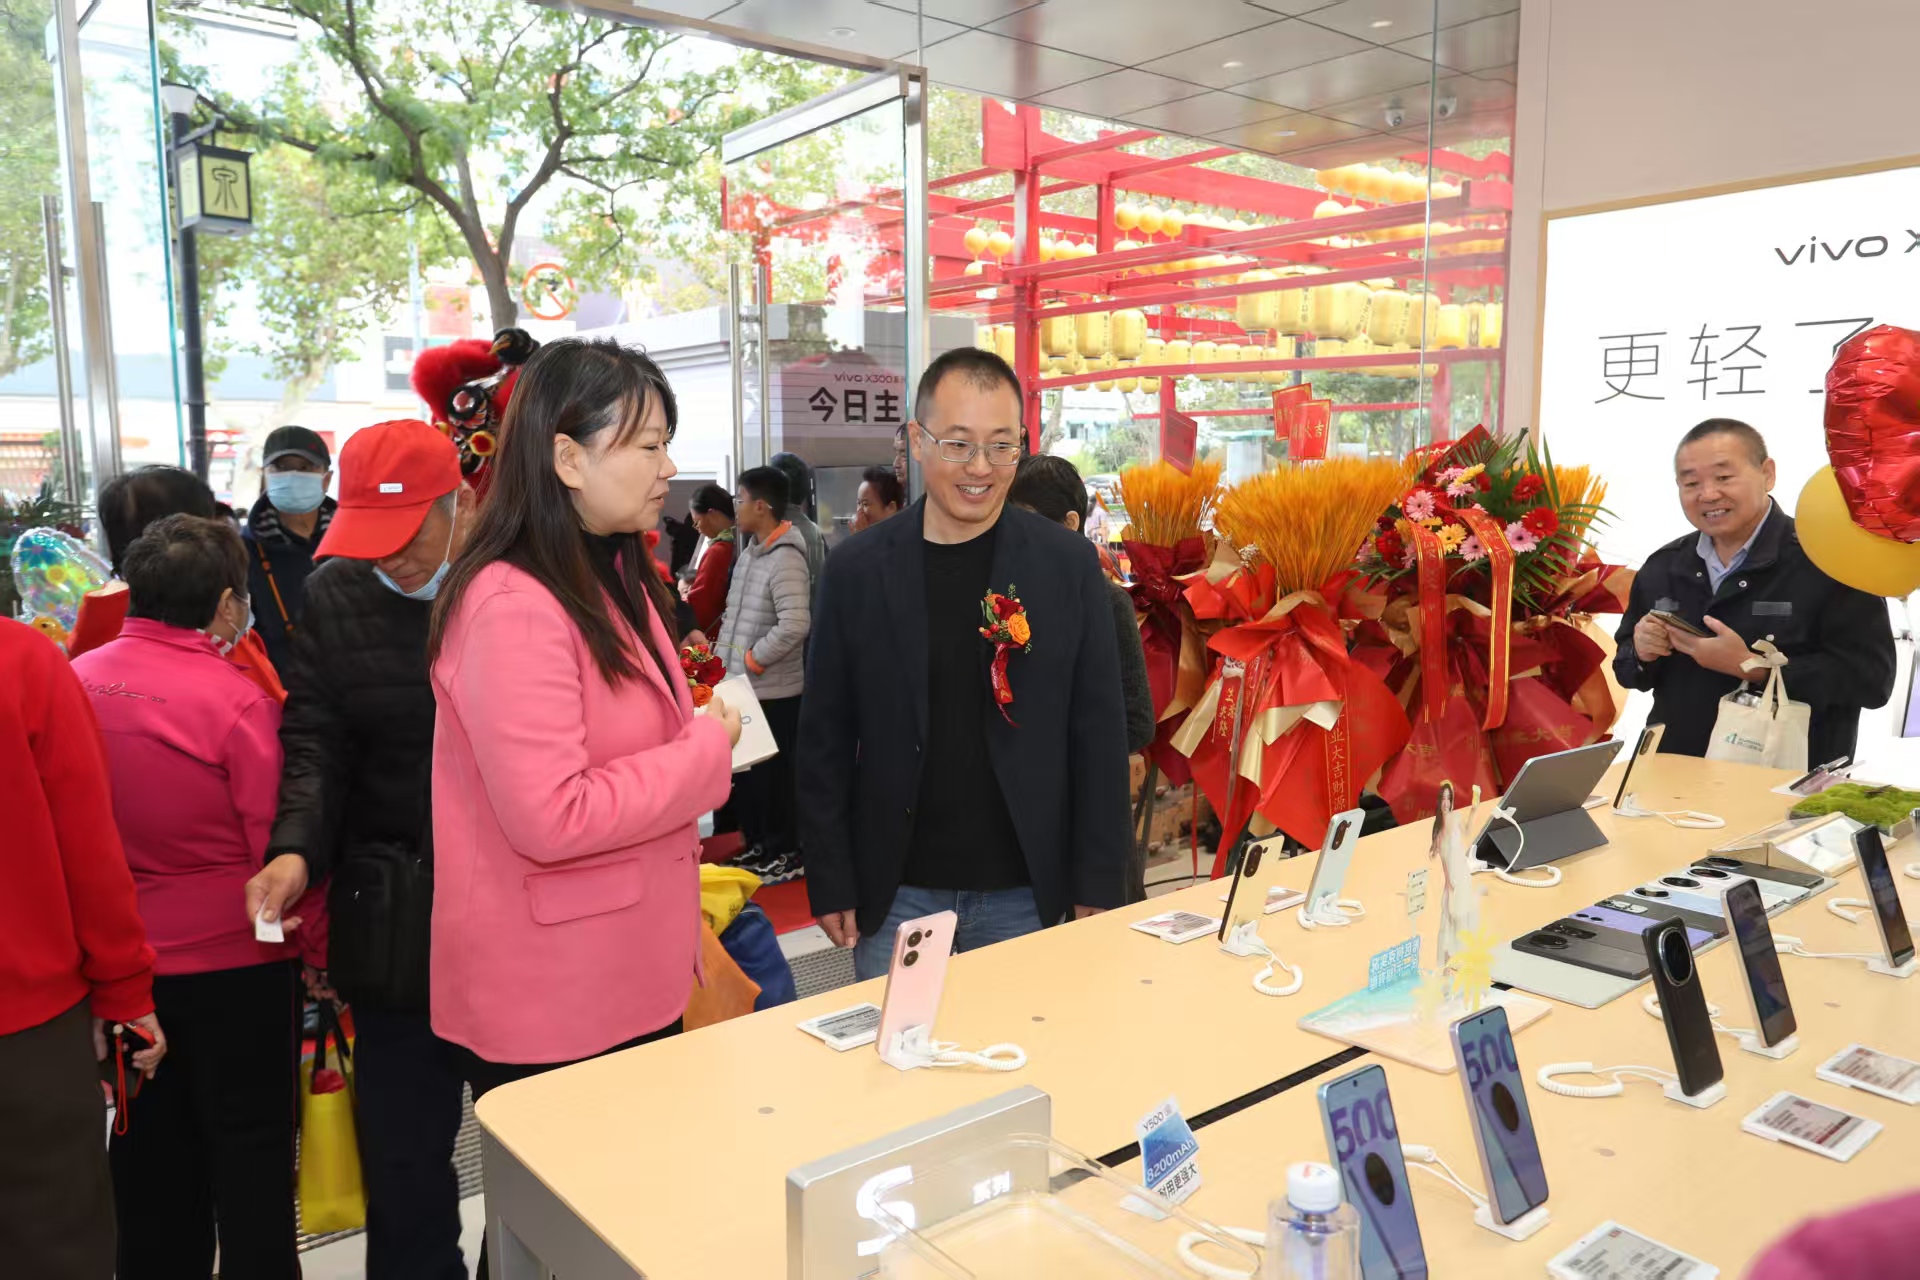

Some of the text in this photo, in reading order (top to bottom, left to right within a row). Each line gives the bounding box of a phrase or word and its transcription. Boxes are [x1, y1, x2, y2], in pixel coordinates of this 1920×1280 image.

[1774, 235, 1889, 266] vivo
[834, 371, 863, 382] vivo
[808, 386, 901, 423] 今日主
[1462, 1026, 1519, 1093] 500
[1329, 1087, 1398, 1163] 500
[1146, 1139, 1195, 1183] 8200mAh
